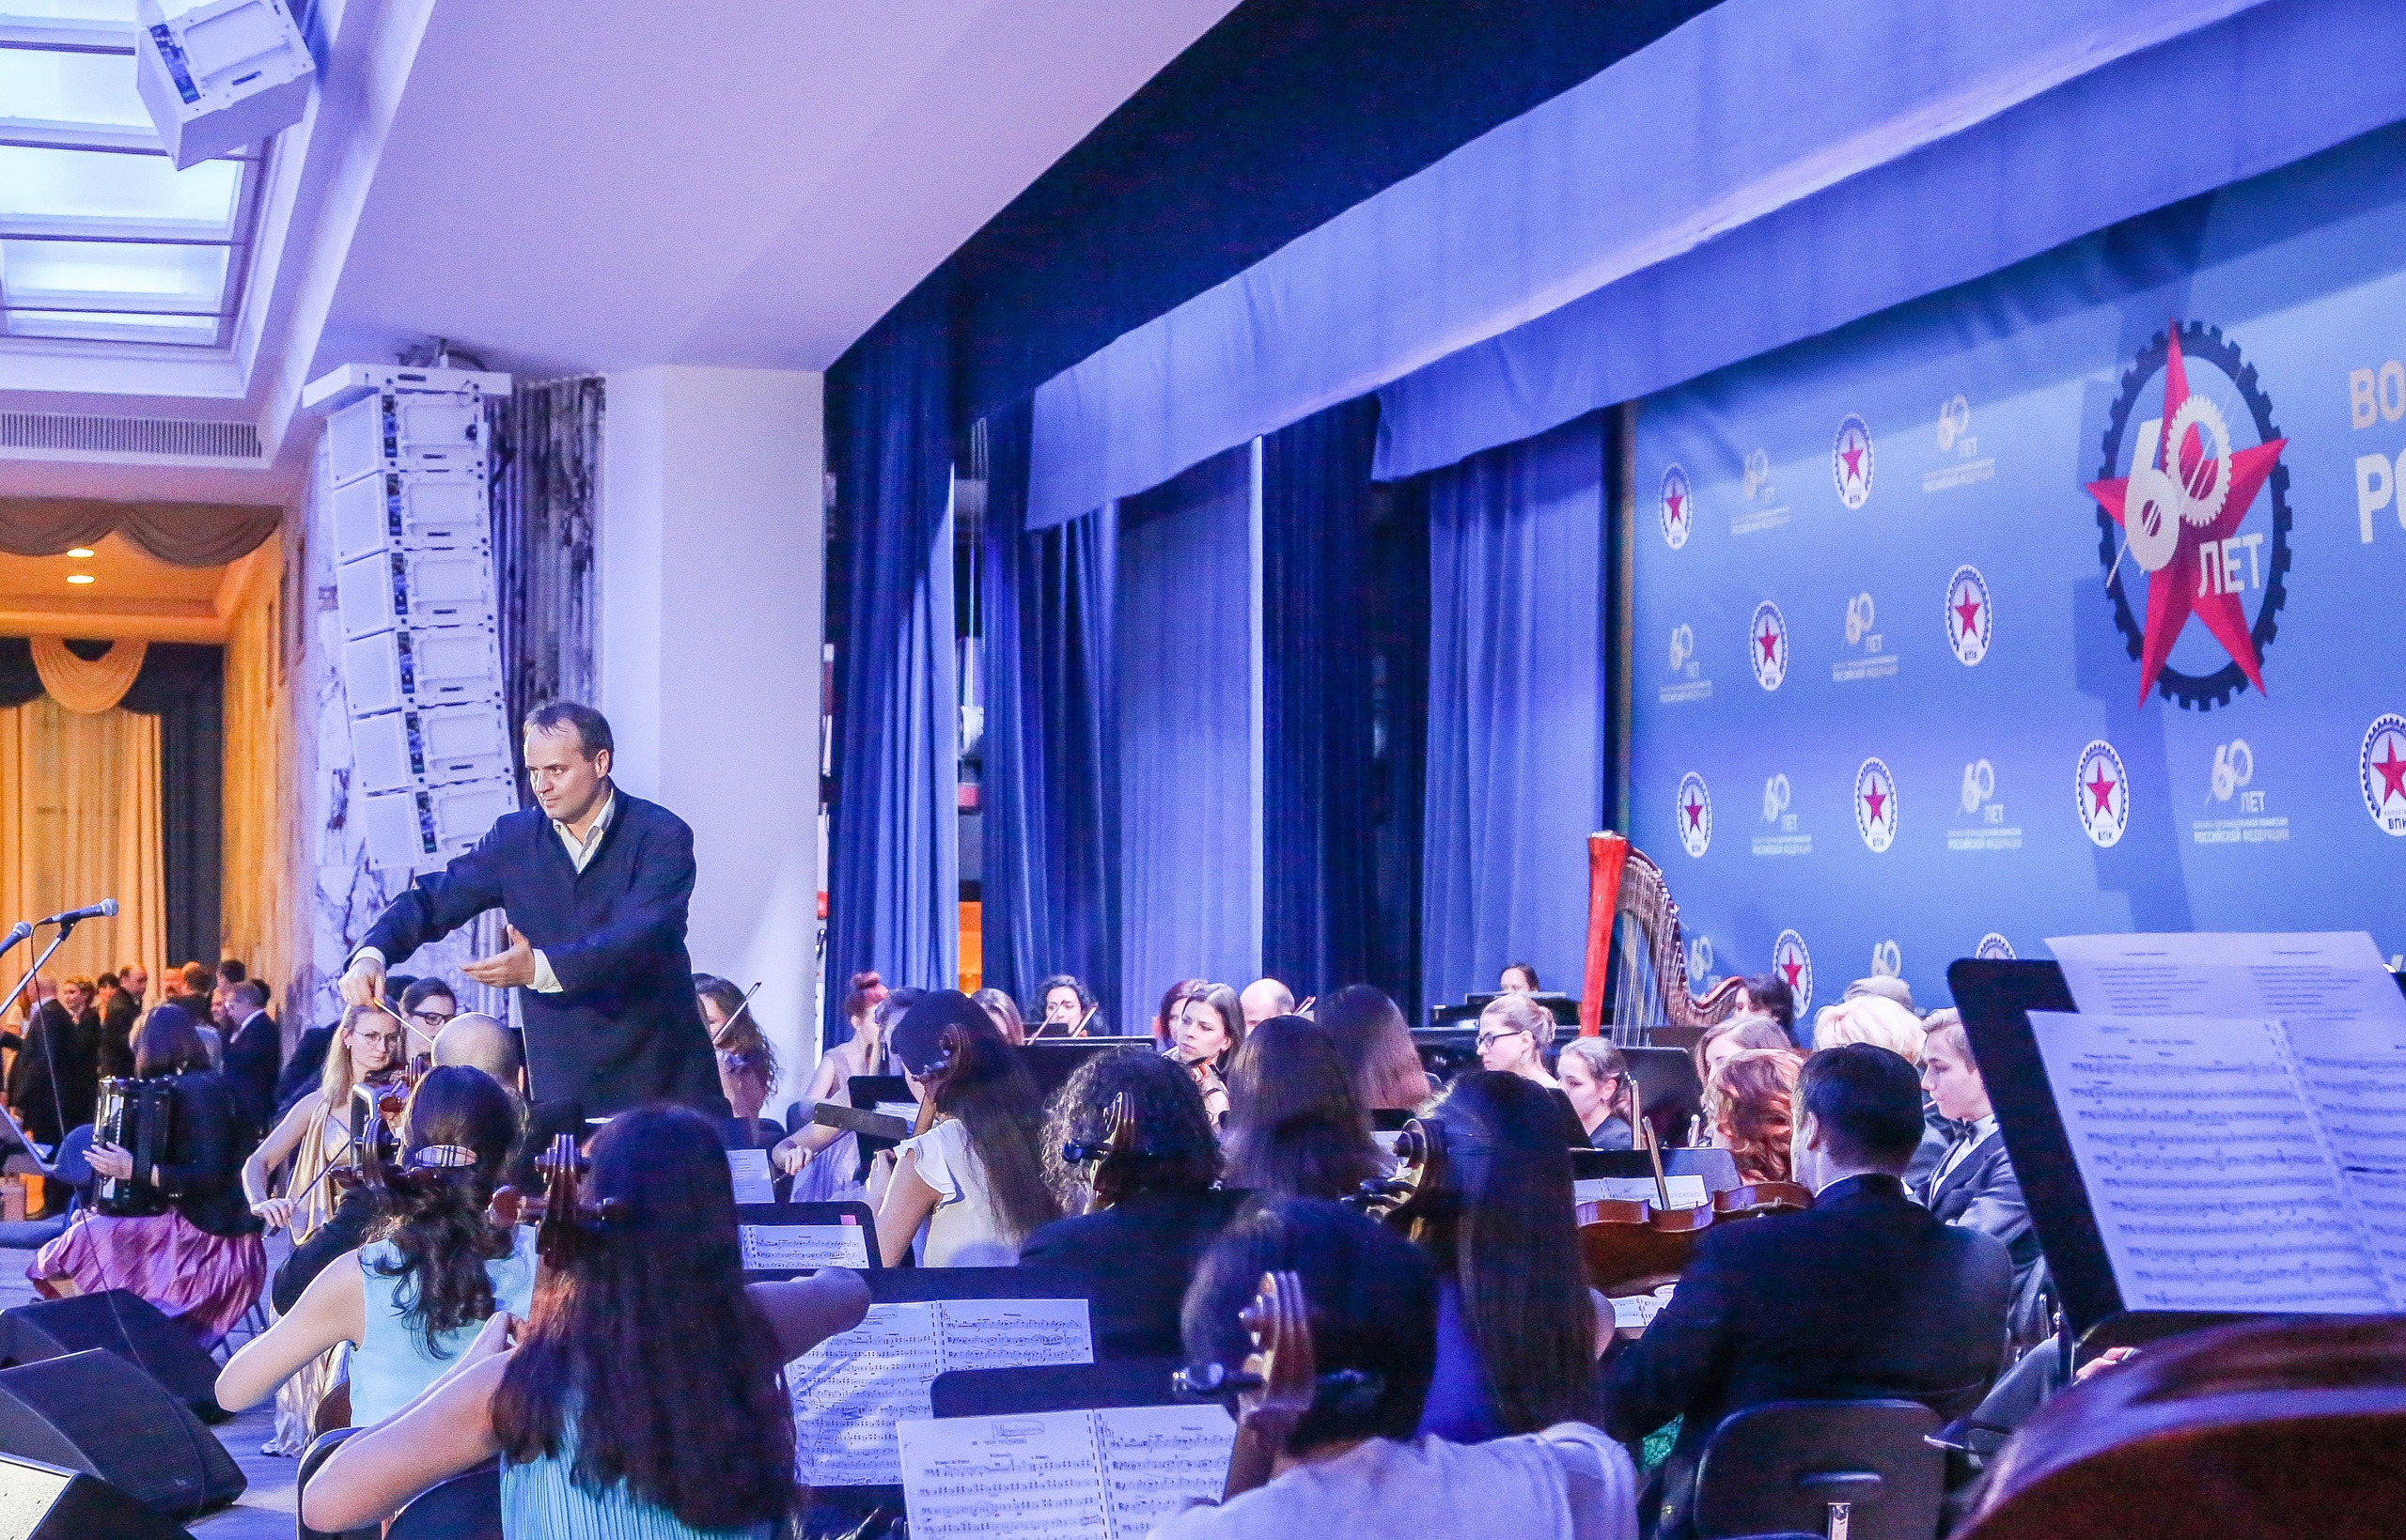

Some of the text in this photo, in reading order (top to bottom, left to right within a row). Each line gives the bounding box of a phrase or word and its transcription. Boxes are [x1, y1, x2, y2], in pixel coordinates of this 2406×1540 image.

[2350, 361, 2406, 429] ВО
[2123, 394, 2233, 572] 60
[2199, 533, 2264, 598] ЛЕТ
[1764, 772, 1790, 822] 60
[1961, 757, 1994, 814] 60
[2211, 739, 2254, 801] 60
